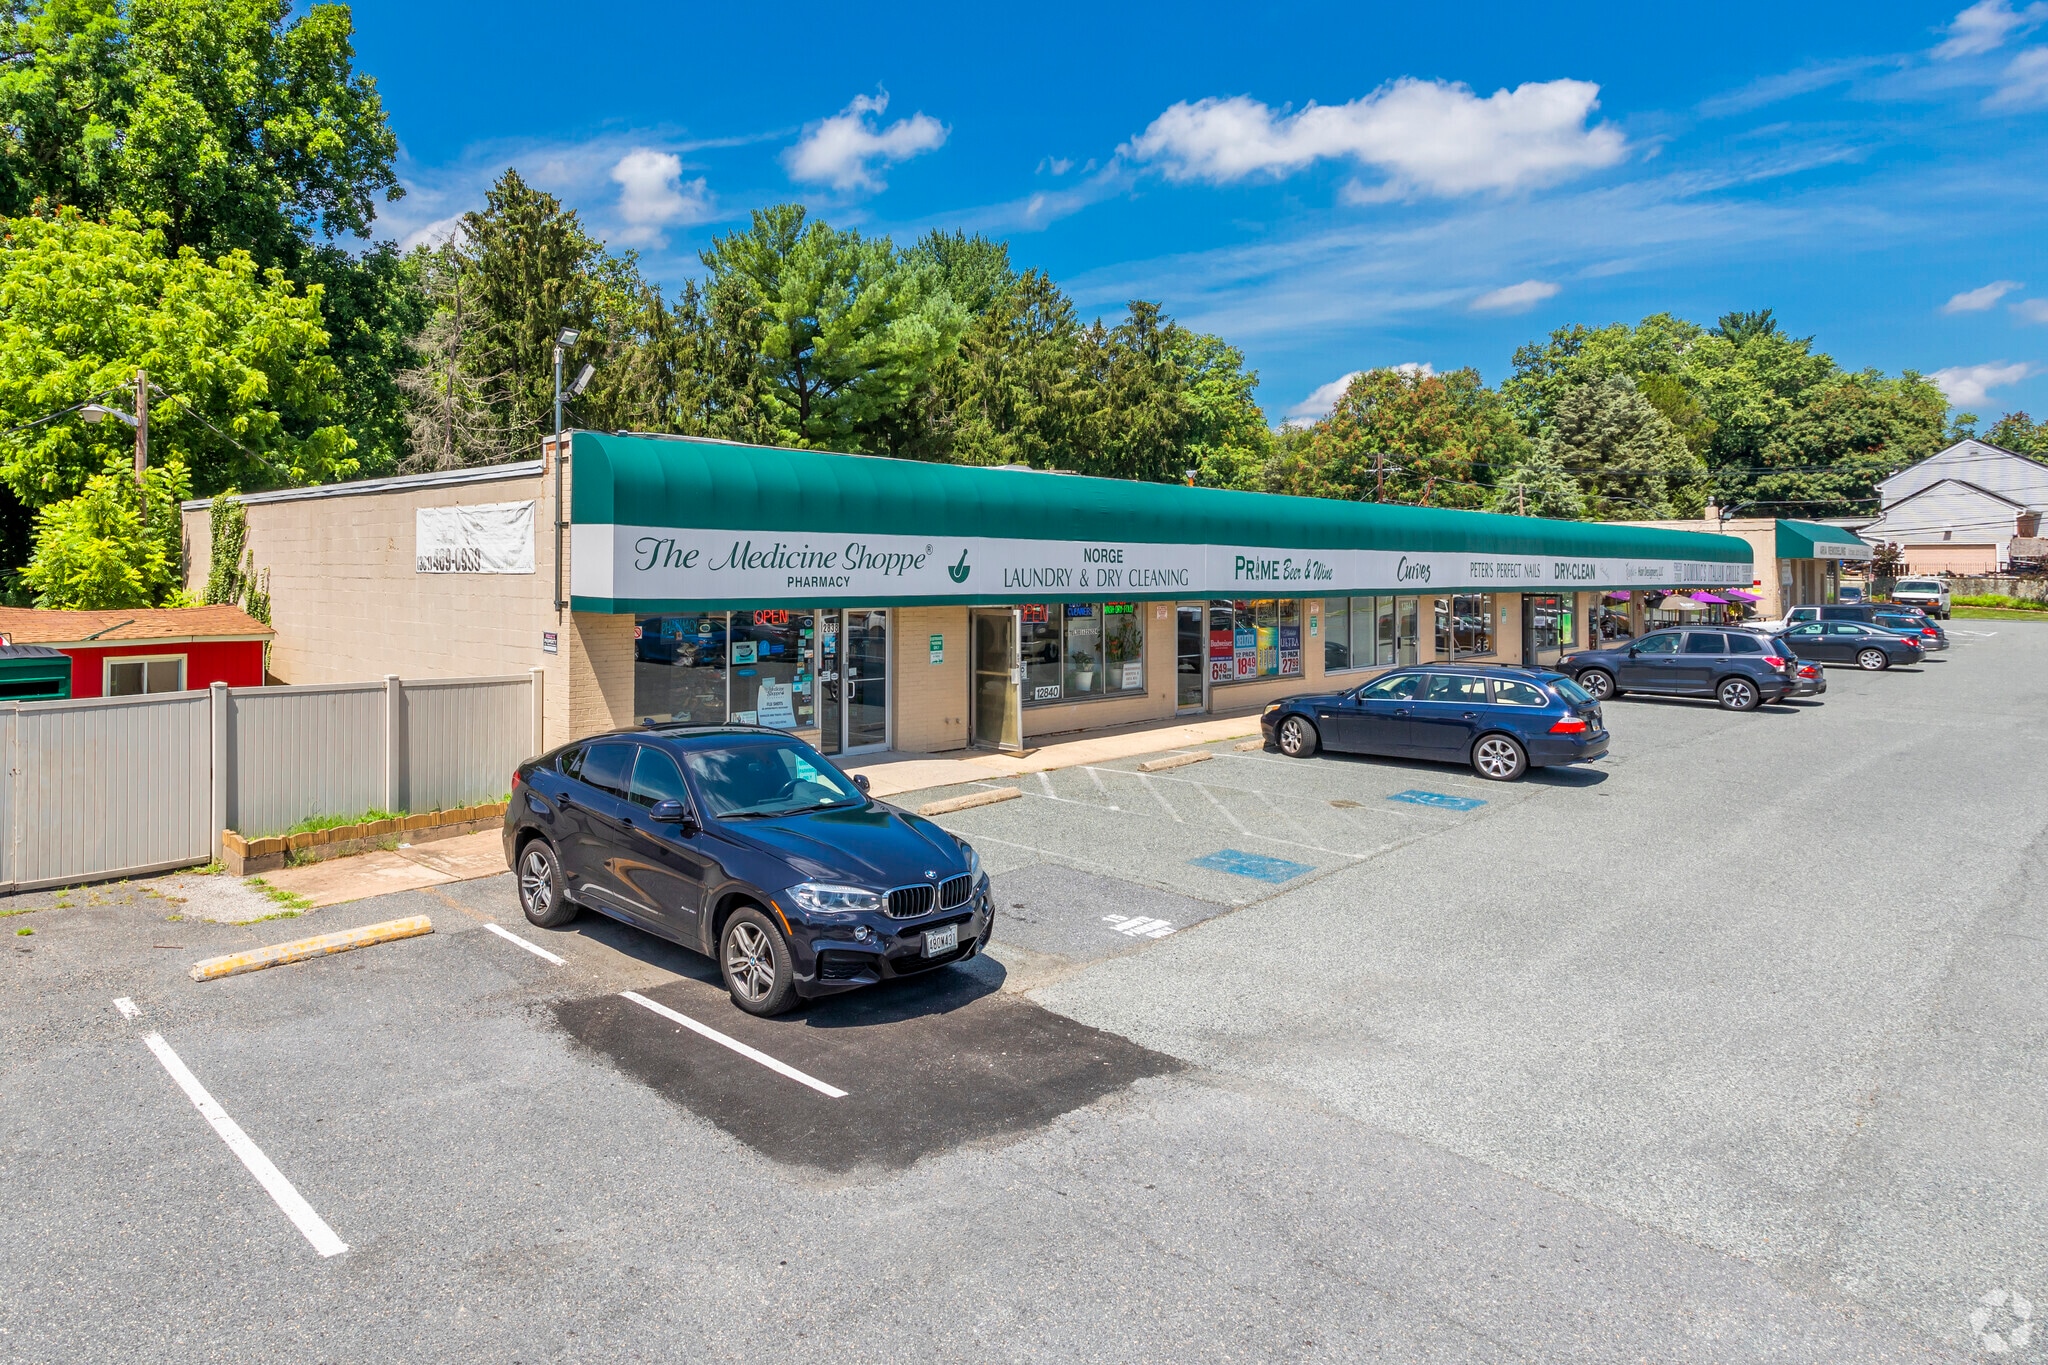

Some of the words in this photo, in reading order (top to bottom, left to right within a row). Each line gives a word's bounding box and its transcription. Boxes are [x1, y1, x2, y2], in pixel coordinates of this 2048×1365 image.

[635, 537, 699, 571] The
[708, 541, 837, 571] Medicine
[1084, 548, 1123, 563] NORGE
[1004, 568, 1073, 587] LAUNDRY
[1080, 568, 1089, 587] &
[1097, 568, 1123, 587] DRY
[1128, 568, 1188, 587] CLEANING
[1283, 558, 1301, 581] Beer
[1304, 558, 1312, 580] &
[1313, 560, 1333, 580] Wine
[1397, 556, 1431, 583] Curves
[1470, 562, 1494, 578] PETER'S
[1497, 563, 1521, 578] PERFECT
[1524, 563, 1541, 578] NAILS
[787, 576, 850, 588] PHARMACY
[755, 610, 788, 624] OPEN
[1019, 604, 1048, 622] OPEN
[1280, 638, 1299, 647] ULTRA
[1036, 687, 1058, 699] 12840
